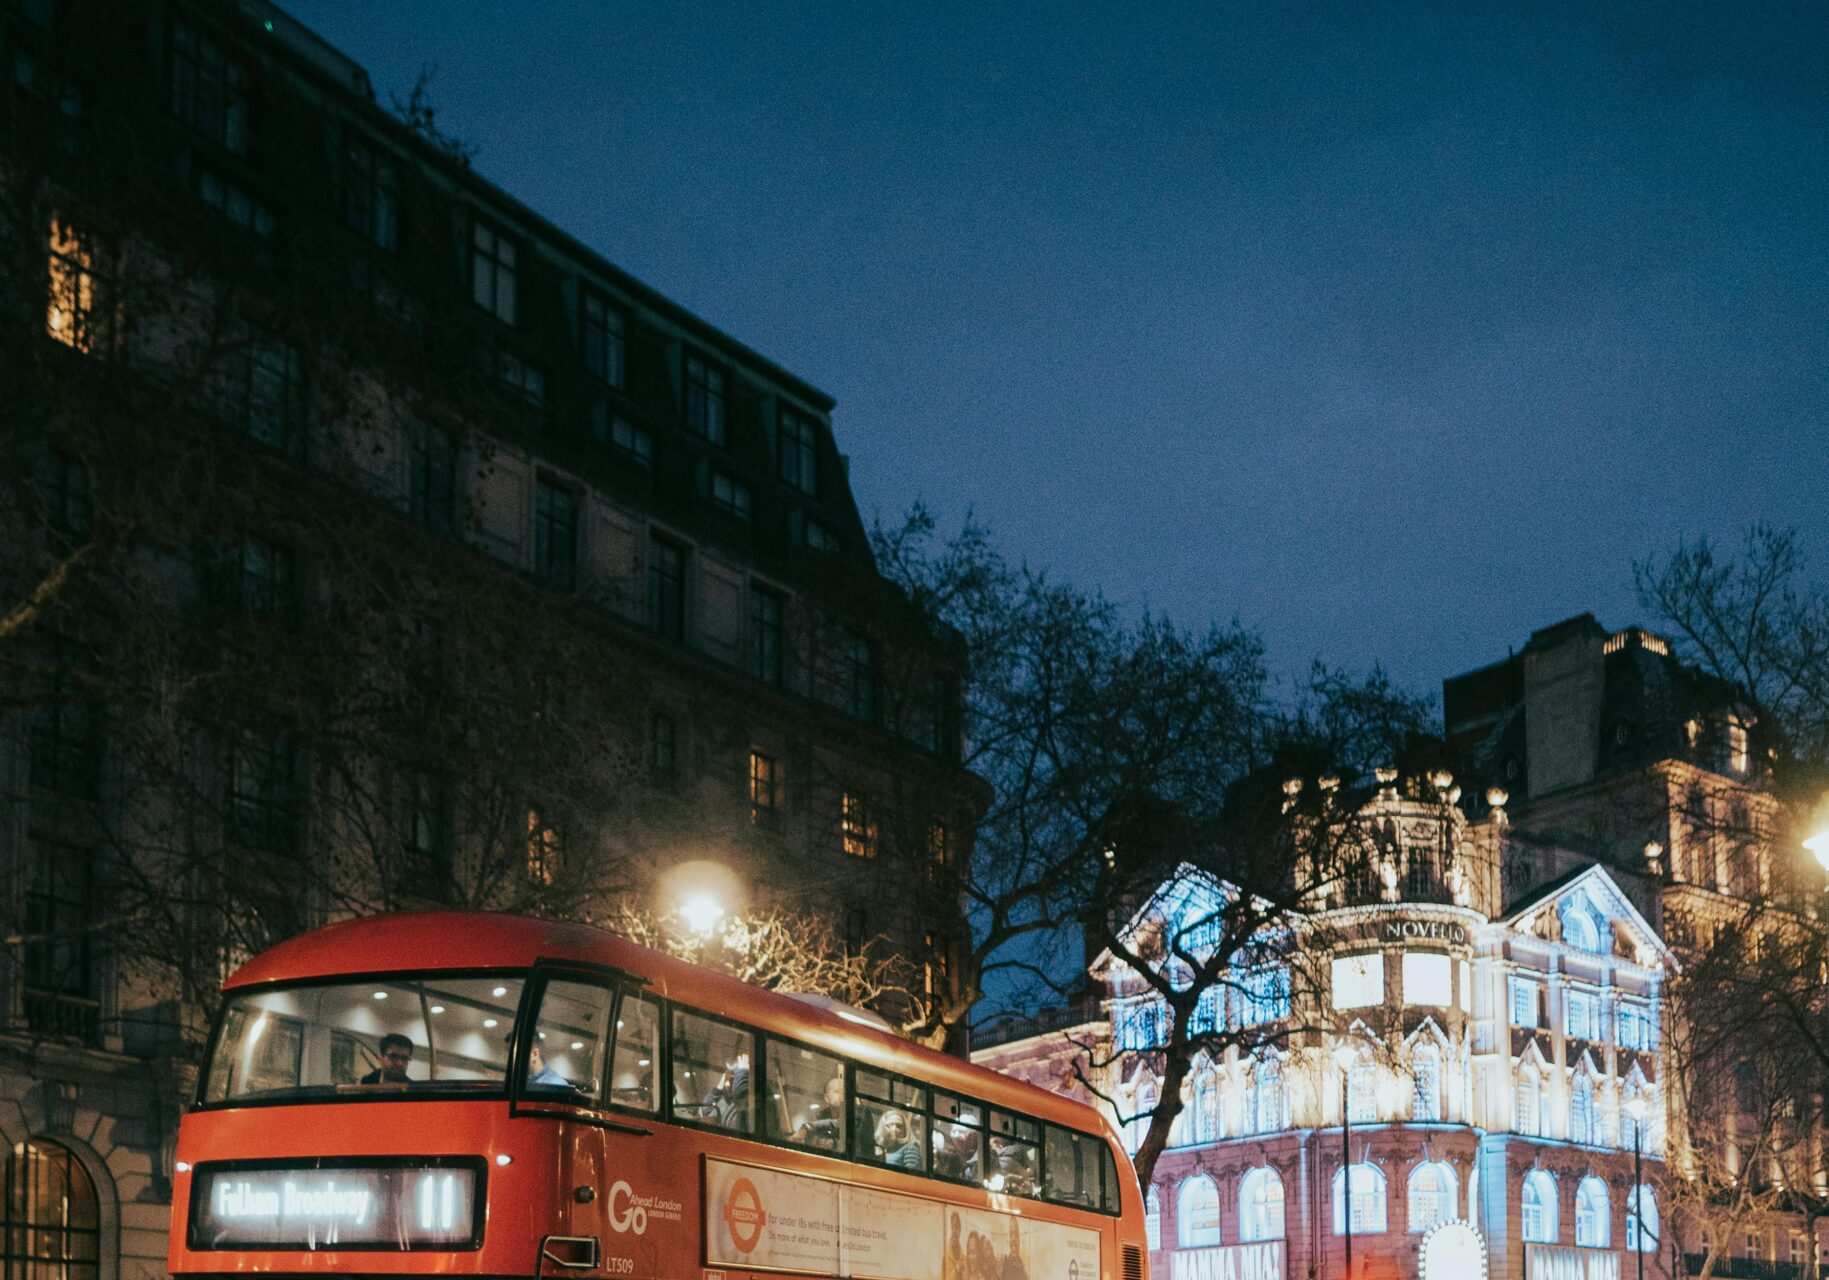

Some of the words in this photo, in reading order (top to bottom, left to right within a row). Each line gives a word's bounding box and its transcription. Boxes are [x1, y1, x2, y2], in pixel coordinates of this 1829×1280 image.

[1386, 921, 1465, 943] NOVELLO
[219, 1182, 280, 1216] Fulham
[284, 1181, 369, 1225] Broadway
[422, 1175, 453, 1229] 11
[630, 1194, 653, 1207] Ahead
[654, 1196, 682, 1211] London
[732, 1208, 759, 1222] FREEDOM
[768, 1213, 778, 1225] for
[779, 1215, 798, 1227] under
[808, 1219, 821, 1231] with
[822, 1220, 834, 1232] free
[862, 1226, 872, 1238] bus
[873, 1228, 888, 1240] travel
[607, 1257, 633, 1274] LT509
